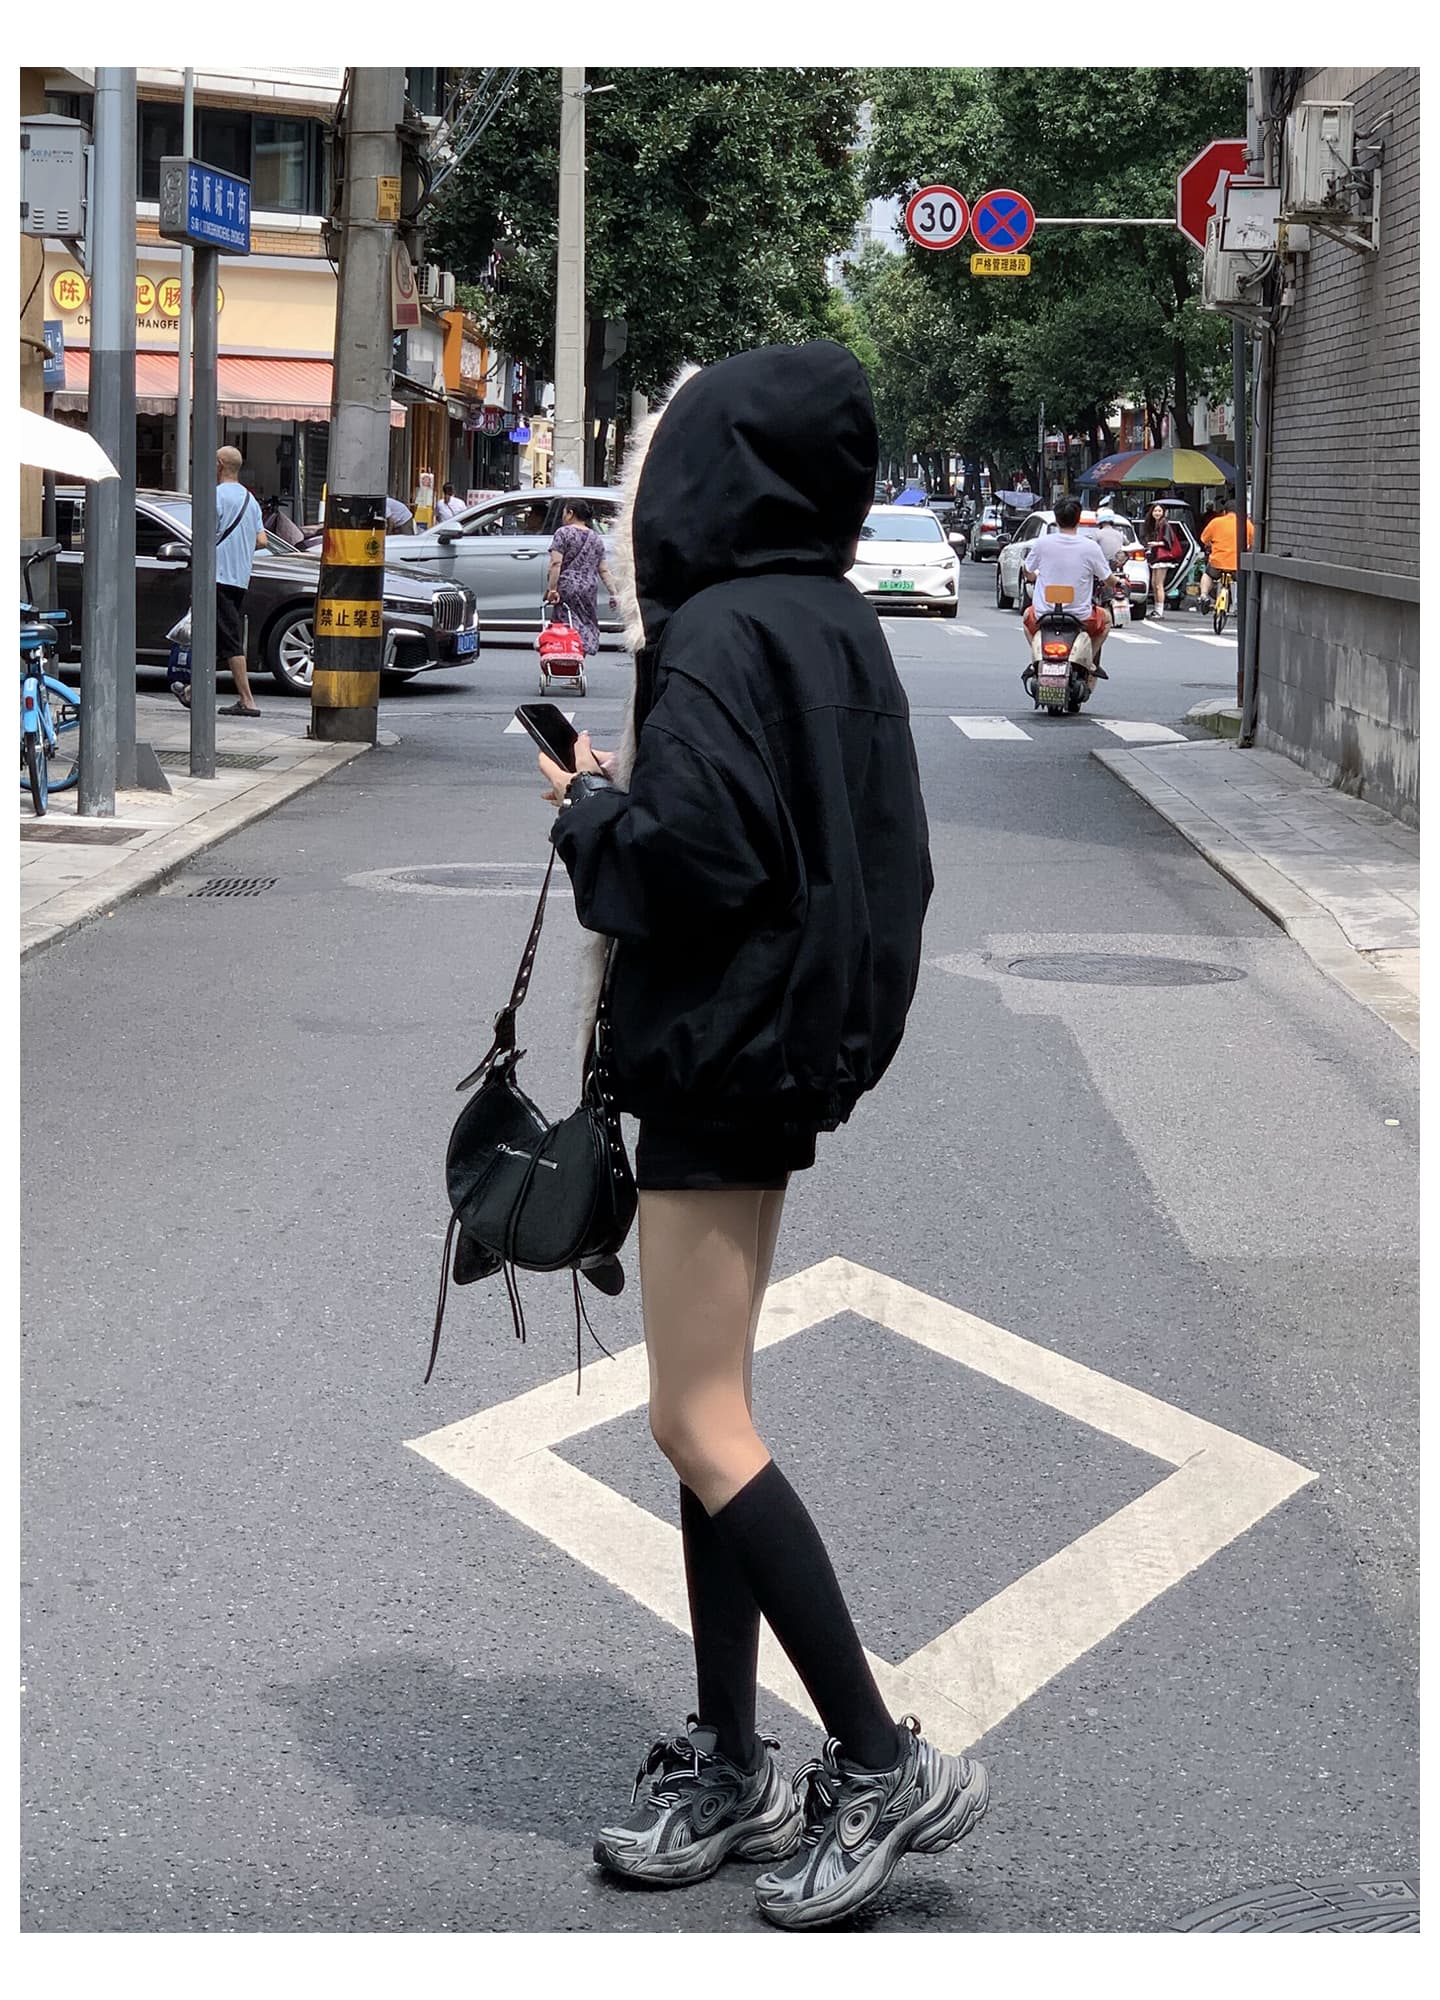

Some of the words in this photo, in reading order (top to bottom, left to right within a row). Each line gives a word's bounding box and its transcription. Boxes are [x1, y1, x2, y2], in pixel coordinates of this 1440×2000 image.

[919, 202, 957, 233] 30
[974, 257, 1027, 272] 严格管理路段
[59, 279, 219, 309] 陈肥肠
[77, 315, 91, 325] CH
[135, 318, 179, 330] HANGFE
[320, 607, 381, 629] 禁止攀登
